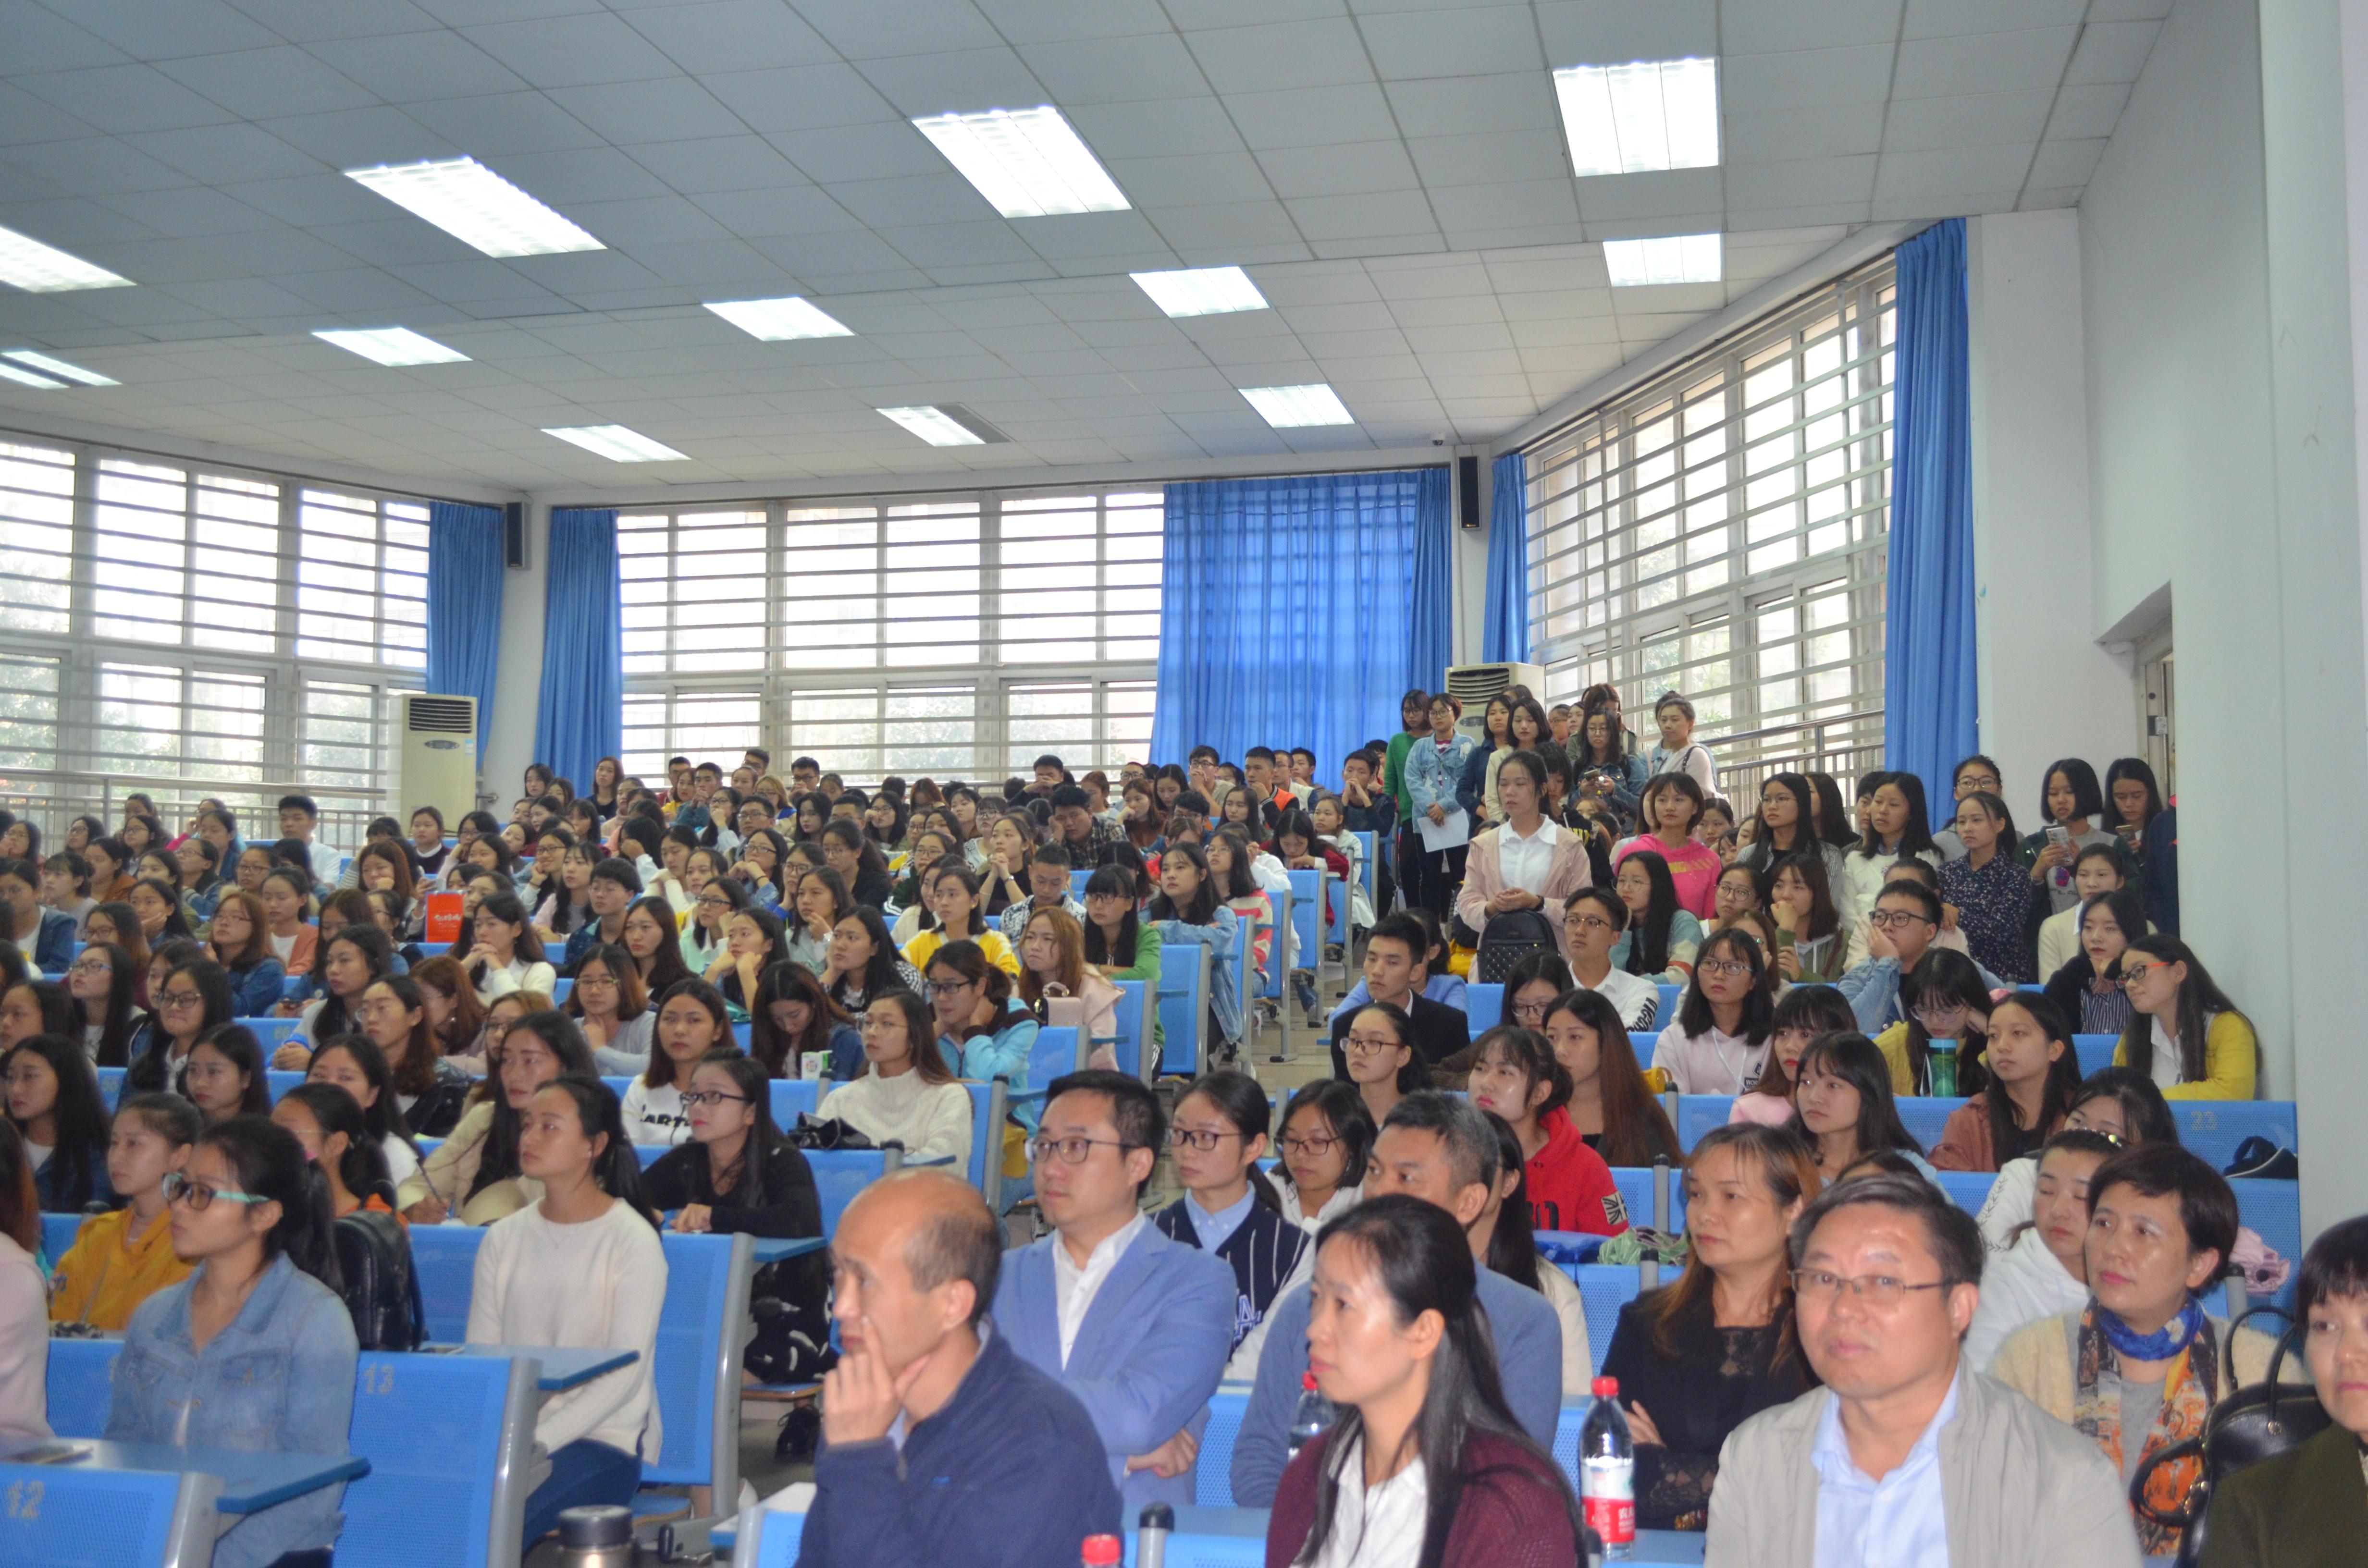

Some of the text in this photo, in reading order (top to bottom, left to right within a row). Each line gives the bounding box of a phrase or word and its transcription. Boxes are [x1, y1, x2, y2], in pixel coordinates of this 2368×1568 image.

[2191, 1110, 2218, 1131] 23
[363, 1362, 394, 1394] 13
[7, 1480, 45, 1519] 12
